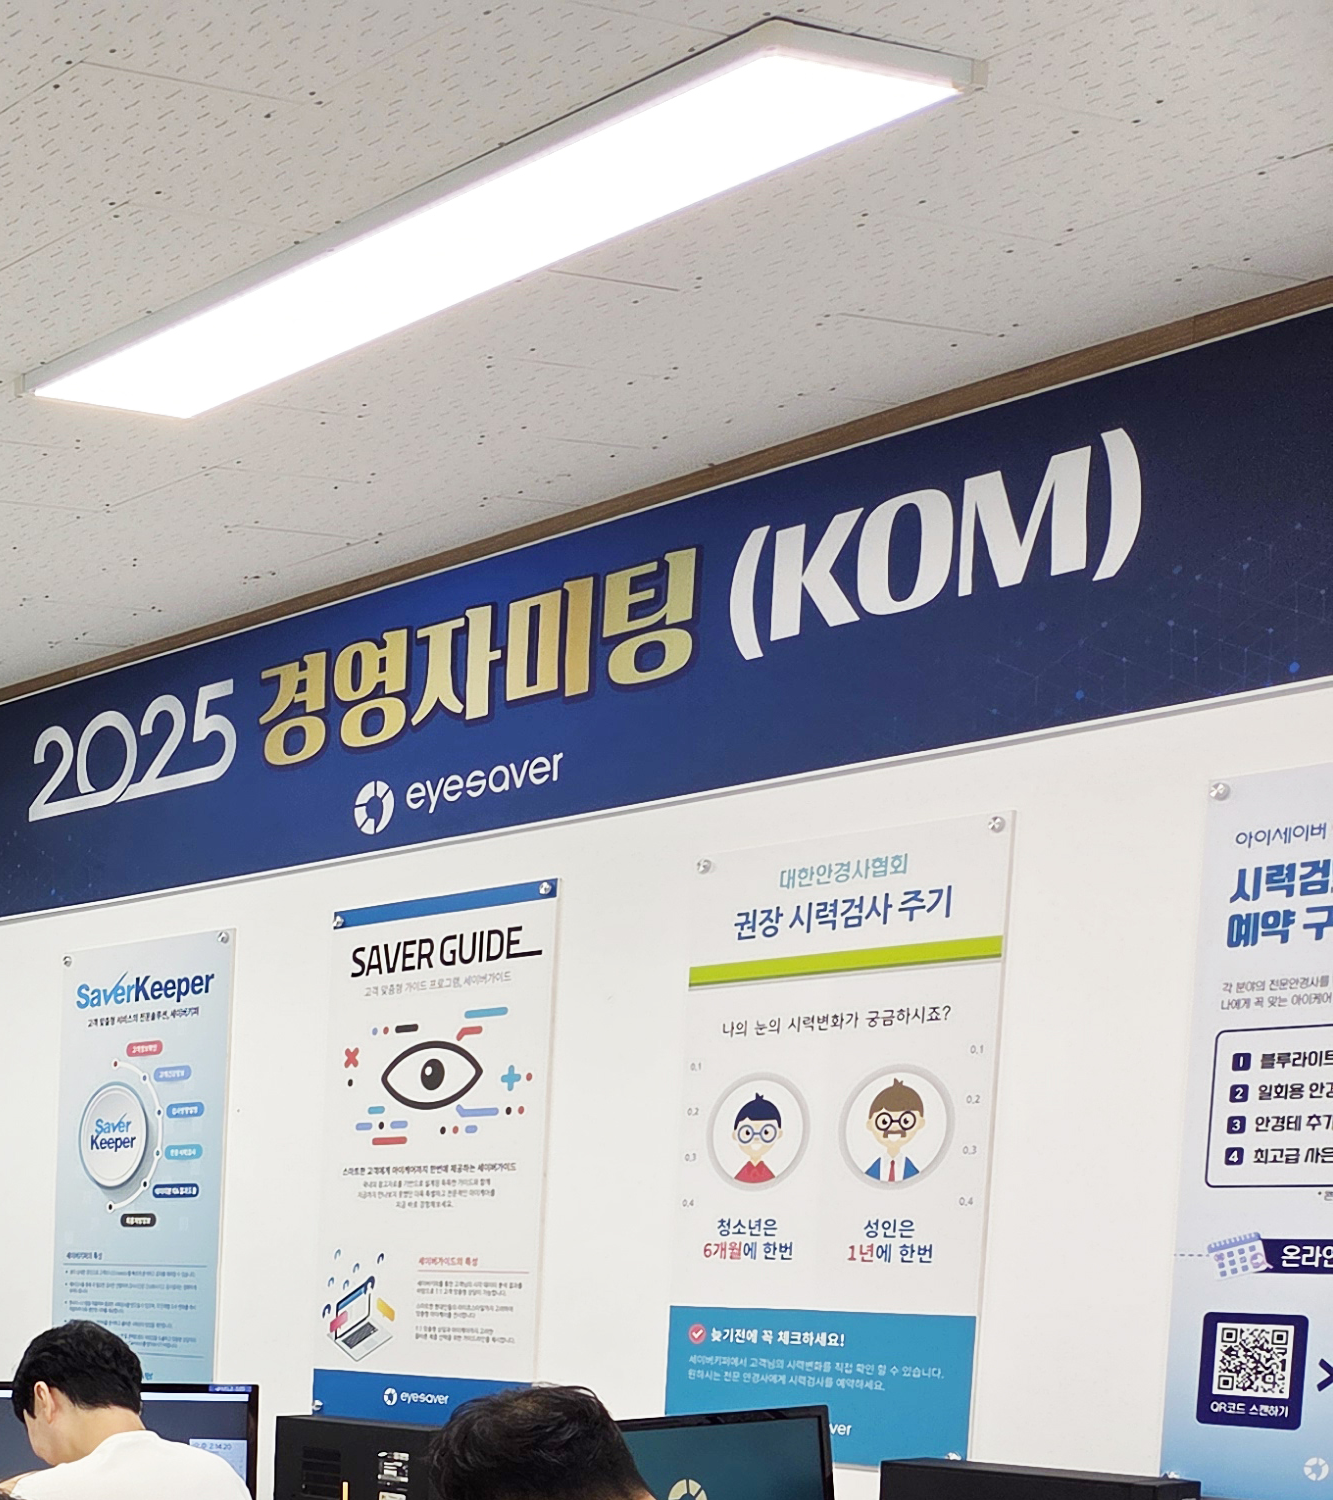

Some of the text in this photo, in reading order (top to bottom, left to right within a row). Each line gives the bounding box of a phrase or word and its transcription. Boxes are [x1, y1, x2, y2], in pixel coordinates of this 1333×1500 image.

[29, 426, 1141, 821] 2025 경영자미팅 (KOM)
[405, 750, 563, 812] eyesaver
[1235, 822, 1327, 848] 아이세이버
[779, 853, 909, 890] 대한안경사협회
[1229, 859, 1333, 903] 시력검
[734, 884, 953, 941] 권장 시력검사 주기
[1227, 909, 1296, 948] 예약
[350, 925, 543, 978] SAVER GUIDE
[76, 971, 215, 1009] SaverKeeper
[1236, 980, 1265, 993] 분야의
[1269, 975, 1330, 992] 전문안경사를
[1221, 998, 1251, 1010] 나에게
[722, 1005, 951, 1038] 나의 눈의 시력변화가 궁금하시죠?
[1258, 1083, 1305, 1101] 일회용
[95, 1113, 132, 1135] Saver
[1255, 1115, 1302, 1132] 안경테
[90, 1134, 136, 1152] Keeper
[1228, 1150, 1239, 1163] 4
[1253, 1147, 1300, 1164] 최고급
[717, 1217, 778, 1238] 청소년은
[863, 1219, 916, 1239] 성인은
[703, 1241, 794, 1261] 6개월에 한번
[847, 1243, 934, 1264] 1년에 한번
[710, 1326, 846, 1348] 늦기전에 꼭 체크하세요!
[750, 1356, 784, 1371] 고객님의
[889, 1365, 900, 1377] 수
[901, 1366, 945, 1380] 있습니다.
[400, 1389, 450, 1405] eyesaver
[1210, 1401, 1246, 1415] QR코드
